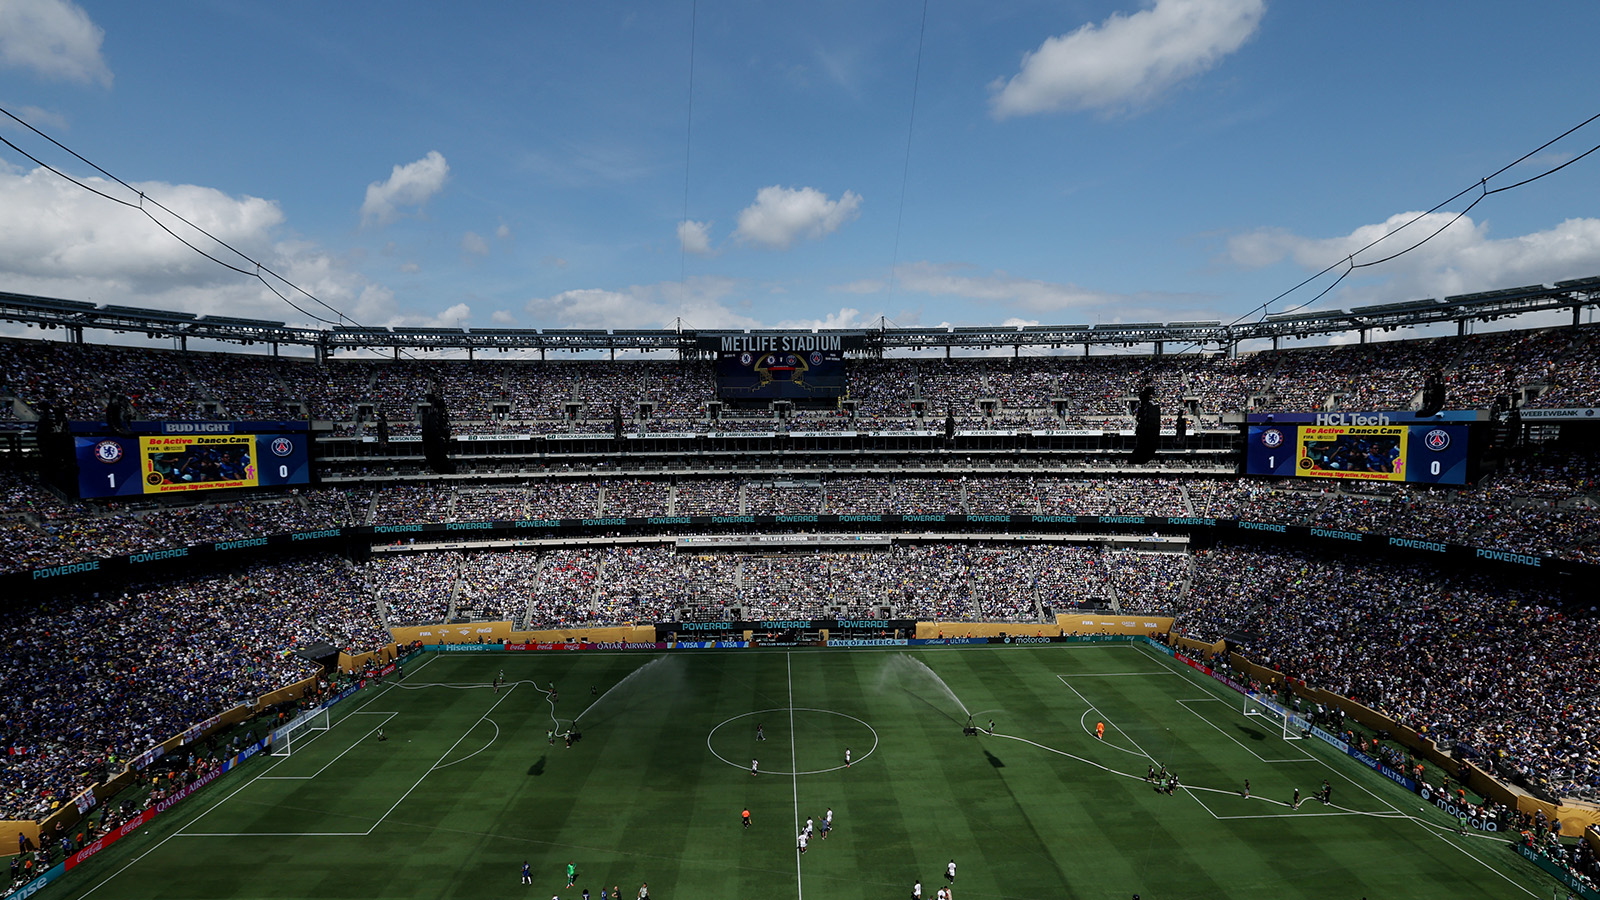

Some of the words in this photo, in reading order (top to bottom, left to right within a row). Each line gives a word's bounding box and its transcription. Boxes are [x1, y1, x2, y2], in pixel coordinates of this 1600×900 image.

[721, 336, 778, 351] METLIFE
[781, 336, 841, 351] STADIUM
[1316, 413, 1390, 426] HCLTech
[166, 423, 194, 432] BUD
[194, 422, 230, 432] LIGHT
[1268, 456, 1275, 469] 1
[1430, 460, 1440, 476] 0
[279, 464, 288, 478] 0
[107, 472, 116, 488] 1
[374, 524, 424, 533] POWERADE
[446, 522, 493, 530] POWERADE
[1238, 521, 1286, 533] POWERADE
[292, 528, 341, 541] POWERADE
[1310, 528, 1363, 542] POWERADE
[215, 537, 268, 551] POWERADE
[1389, 537, 1446, 552] POWERADE
[129, 547, 189, 564] POWERADE
[1476, 548, 1541, 567] POWERADE
[33, 560, 100, 580] POWERADE
[682, 622, 734, 630] POWERADE
[837, 620, 889, 628] POWERADE
[1211, 670, 1227, 684] QATAR
[1315, 728, 1340, 747] AMERICA
[243, 744, 259, 758] VISA
[1382, 767, 1407, 787] ULTRA
[156, 787, 186, 812] QATAR
[188, 767, 221, 792] AIRWAYS
[121, 814, 144, 836] Coca-Cola
[77, 839, 103, 863] Coca-Cola
[1524, 848, 1538, 862] PIF
[1571, 879, 1587, 894] PIF
